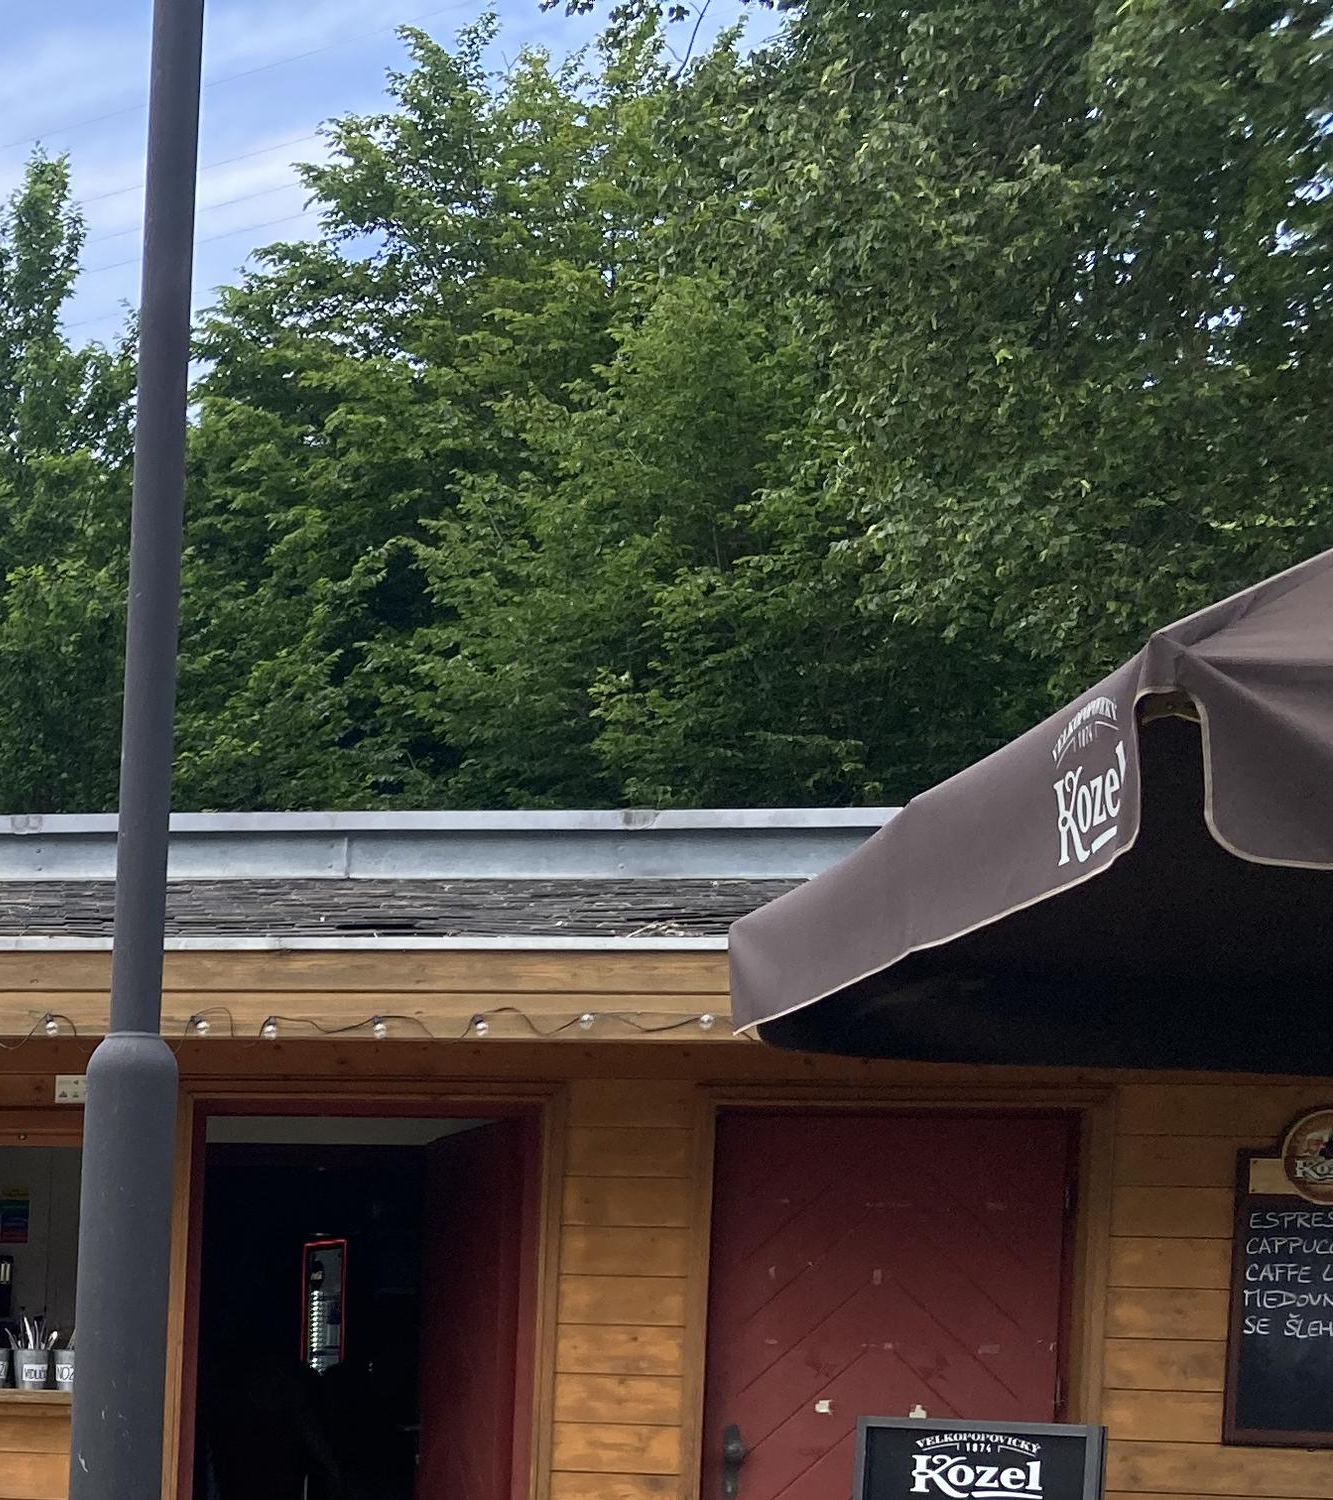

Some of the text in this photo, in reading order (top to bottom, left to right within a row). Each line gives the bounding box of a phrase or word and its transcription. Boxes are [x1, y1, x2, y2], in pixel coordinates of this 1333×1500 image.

[1053, 740, 1126, 866] Kozel
[1294, 1159, 1333, 1180] Ko
[1246, 1263, 1312, 1283] CAFFE
[1243, 1315, 1271, 1334] SE
[915, 1433, 1041, 1453] VELKOPOPOVICKÝ
[966, 1442, 991, 1453] 1874
[910, 1454, 1043, 1498] Kozel
